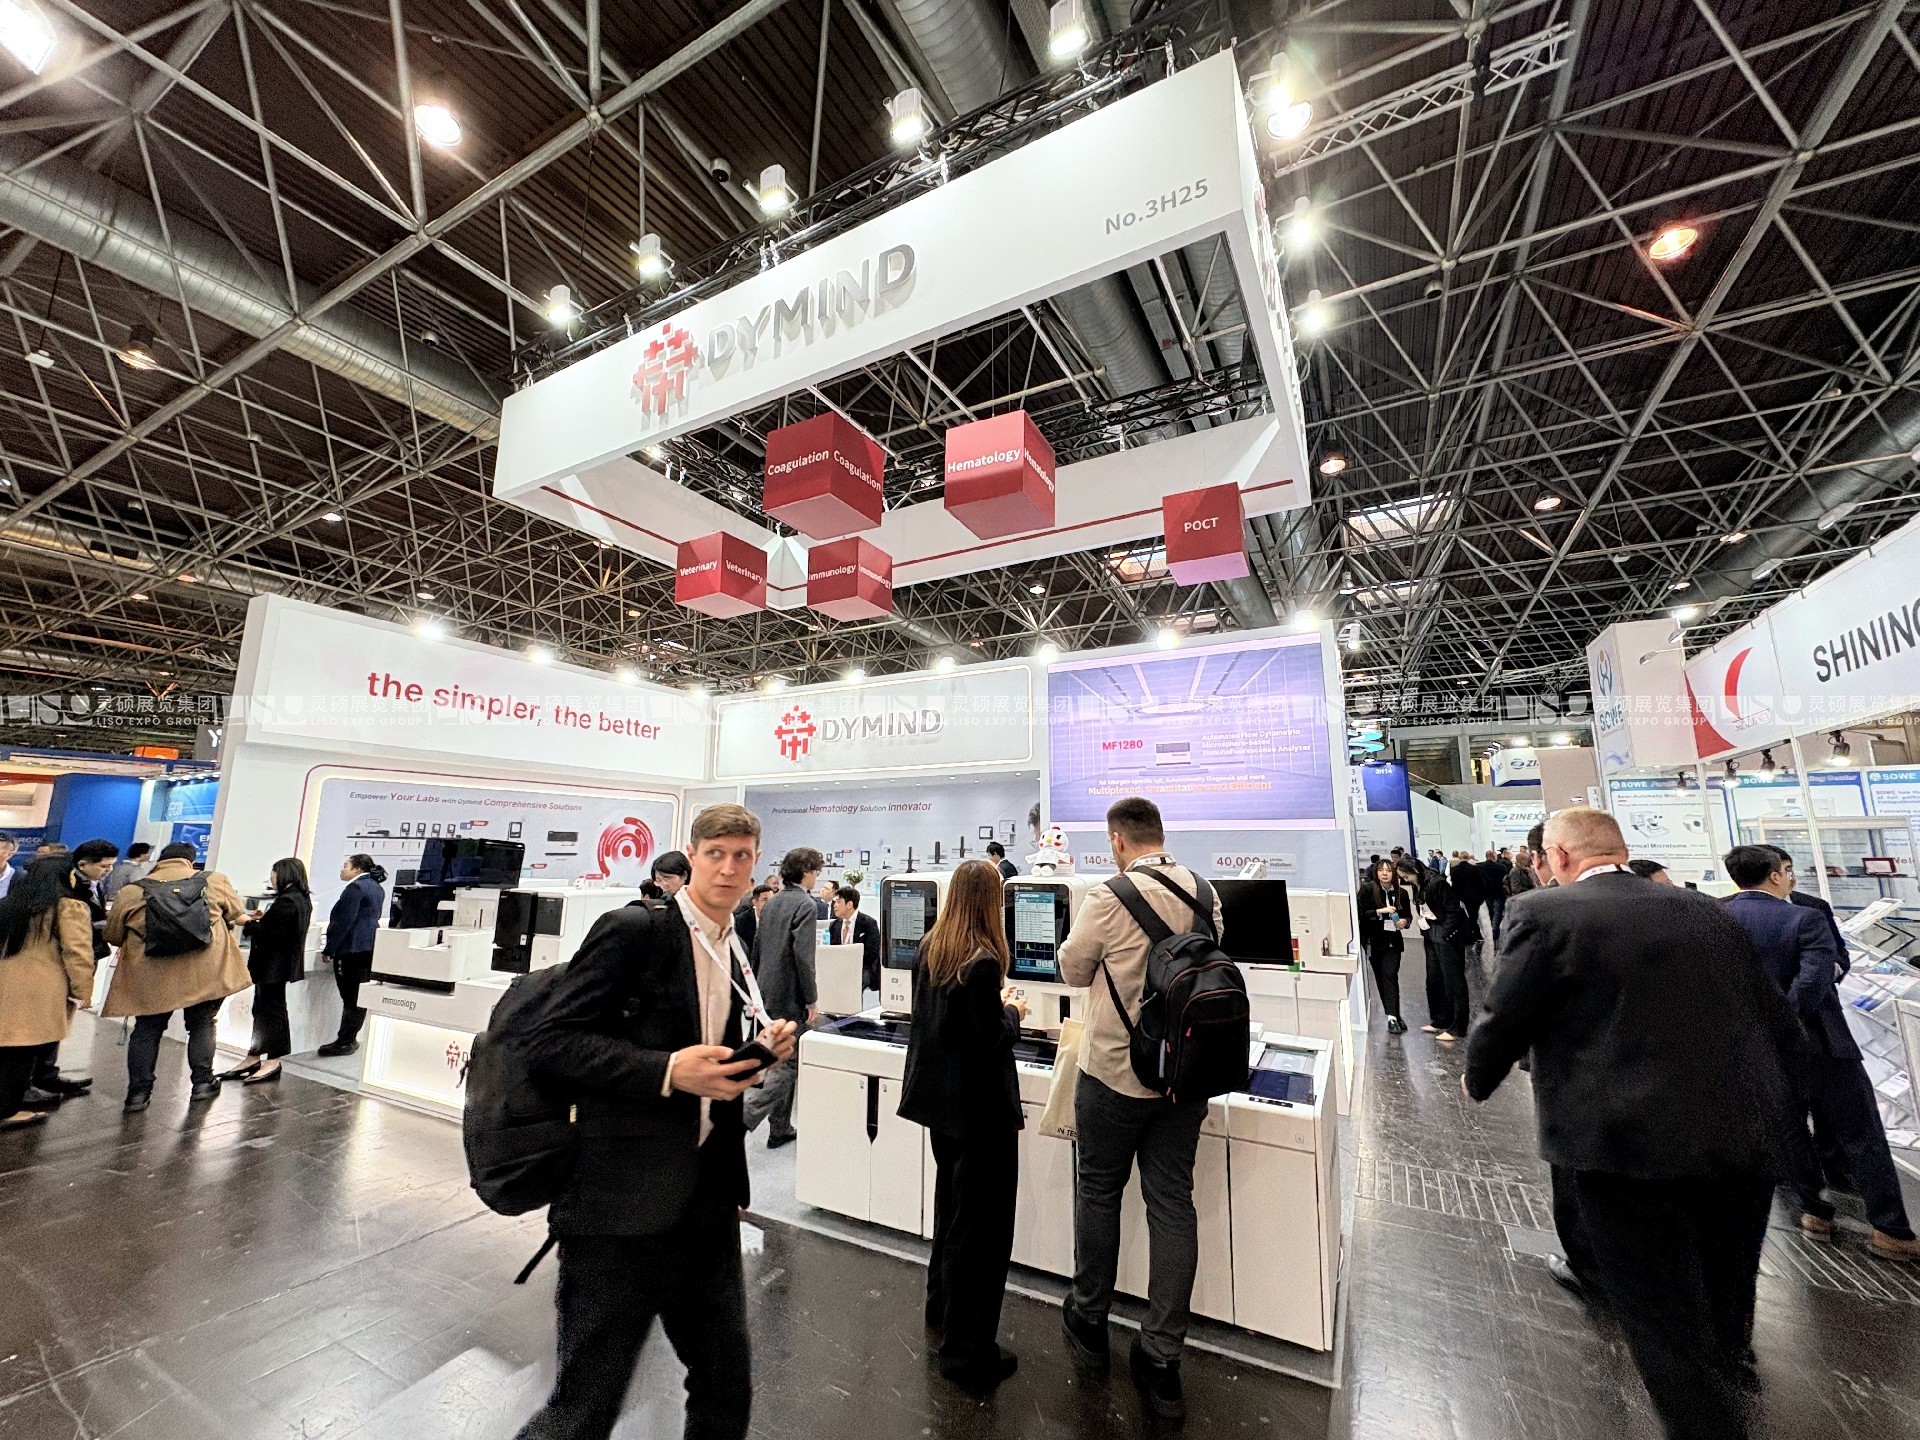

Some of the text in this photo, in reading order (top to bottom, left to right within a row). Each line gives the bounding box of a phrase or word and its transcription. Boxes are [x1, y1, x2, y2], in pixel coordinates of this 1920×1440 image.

[1105, 178, 1209, 235] No.3H25
[706, 243, 916, 372] DYMIND
[767, 448, 830, 476] Coagulation
[833, 449, 882, 492] Coagulation
[947, 447, 1021, 474] Hematology
[1024, 447, 1056, 494] Hematology
[1184, 517, 1219, 533] POCT
[679, 560, 718, 577] Veterinary
[725, 560, 764, 584] Veterinary
[808, 565, 857, 581] Immunology
[859, 563, 893, 589] Immunology
[367, 672, 661, 740] the simpler, the better
[821, 708, 944, 742] DYMIND
[1102, 740, 1143, 750] MF1280
[1882, 772, 1917, 780] SOWE
[349, 791, 388, 801] Empower
[390, 792, 414, 802] Your
[416, 794, 440, 803] Labs
[483, 799, 547, 809] Comprehensive
[549, 802, 582, 811] Solutions
[808, 804, 859, 815] Hematology
[1083, 855, 1108, 865] 140+
